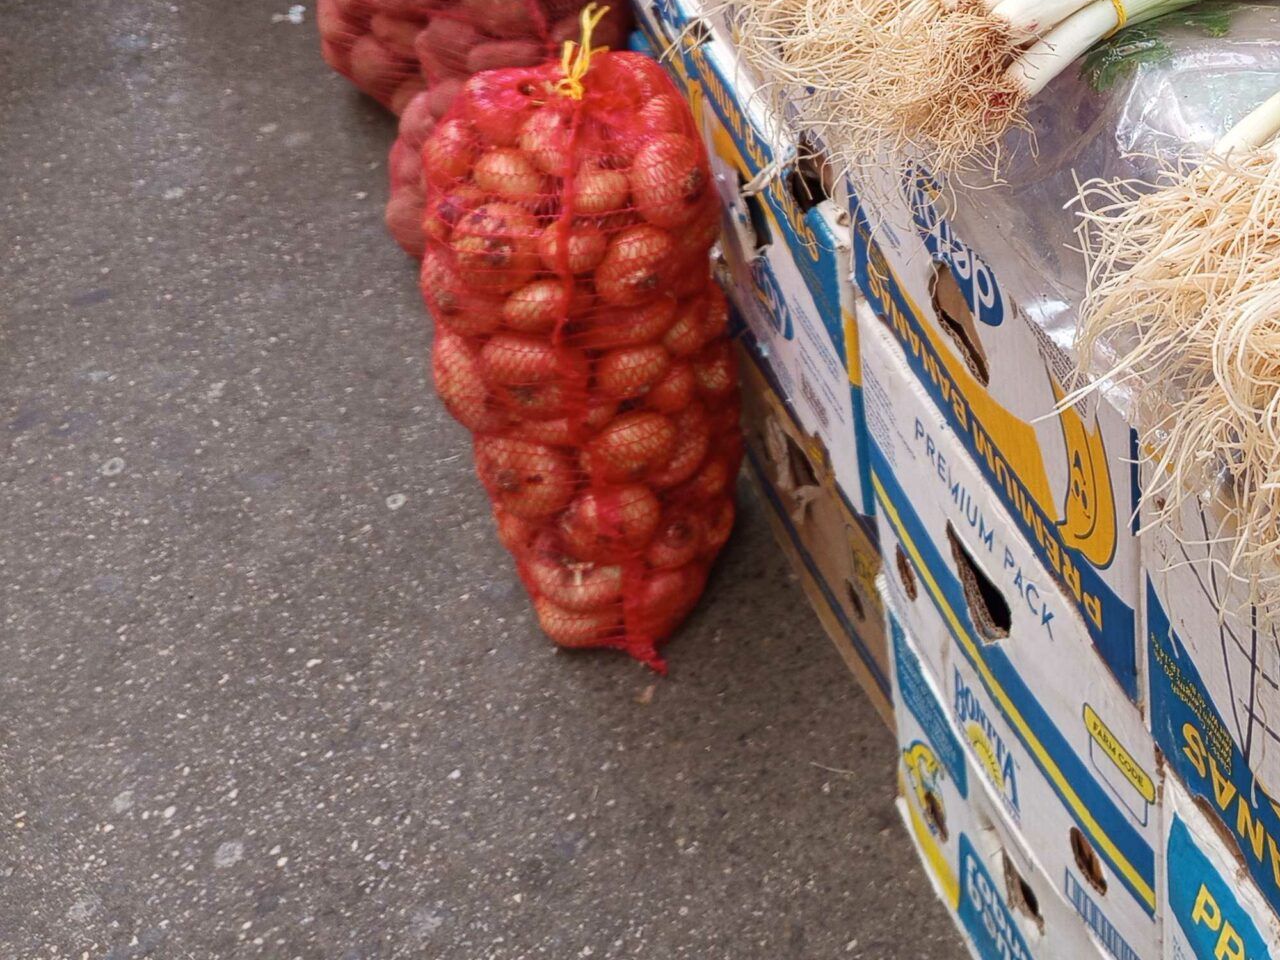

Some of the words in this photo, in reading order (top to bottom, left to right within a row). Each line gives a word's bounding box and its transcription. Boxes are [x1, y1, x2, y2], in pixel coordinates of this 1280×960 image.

[867, 259, 968, 432] BANANAS
[915, 417, 994, 552] PREMIUM
[1004, 545, 1055, 641] PACK
[972, 421, 1103, 632] PREMIUM
[1092, 721, 1117, 756] FARM
[1118, 753, 1145, 788] CODE
